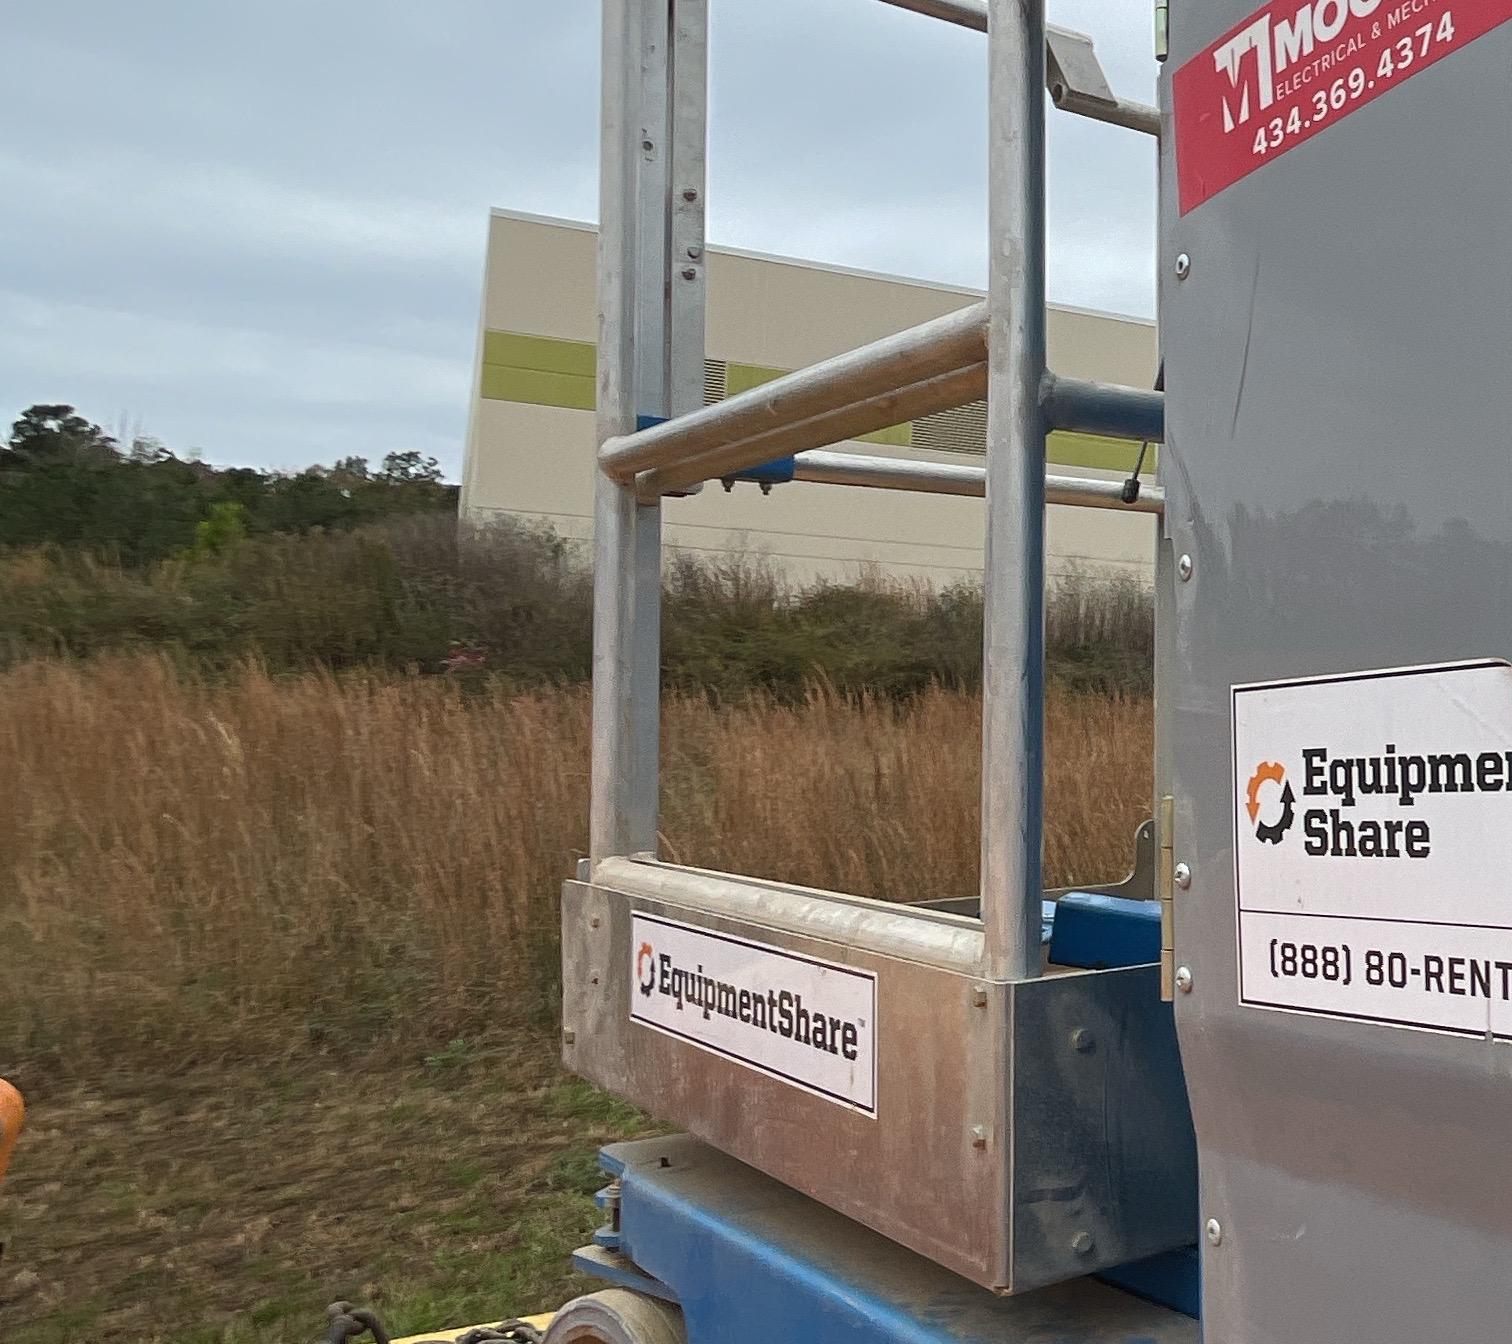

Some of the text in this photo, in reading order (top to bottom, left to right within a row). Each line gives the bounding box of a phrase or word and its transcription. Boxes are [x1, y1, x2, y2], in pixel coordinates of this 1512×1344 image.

[1252, 11, 1455, 155] 434.369.4374
[1275, 37, 1367, 102] ELECTRICAL
[1370, 22, 1382, 41] &
[1303, 808, 1431, 859] Share
[1269, 938, 1352, 986] (888)
[658, 953, 859, 1062] EquipmentShare
